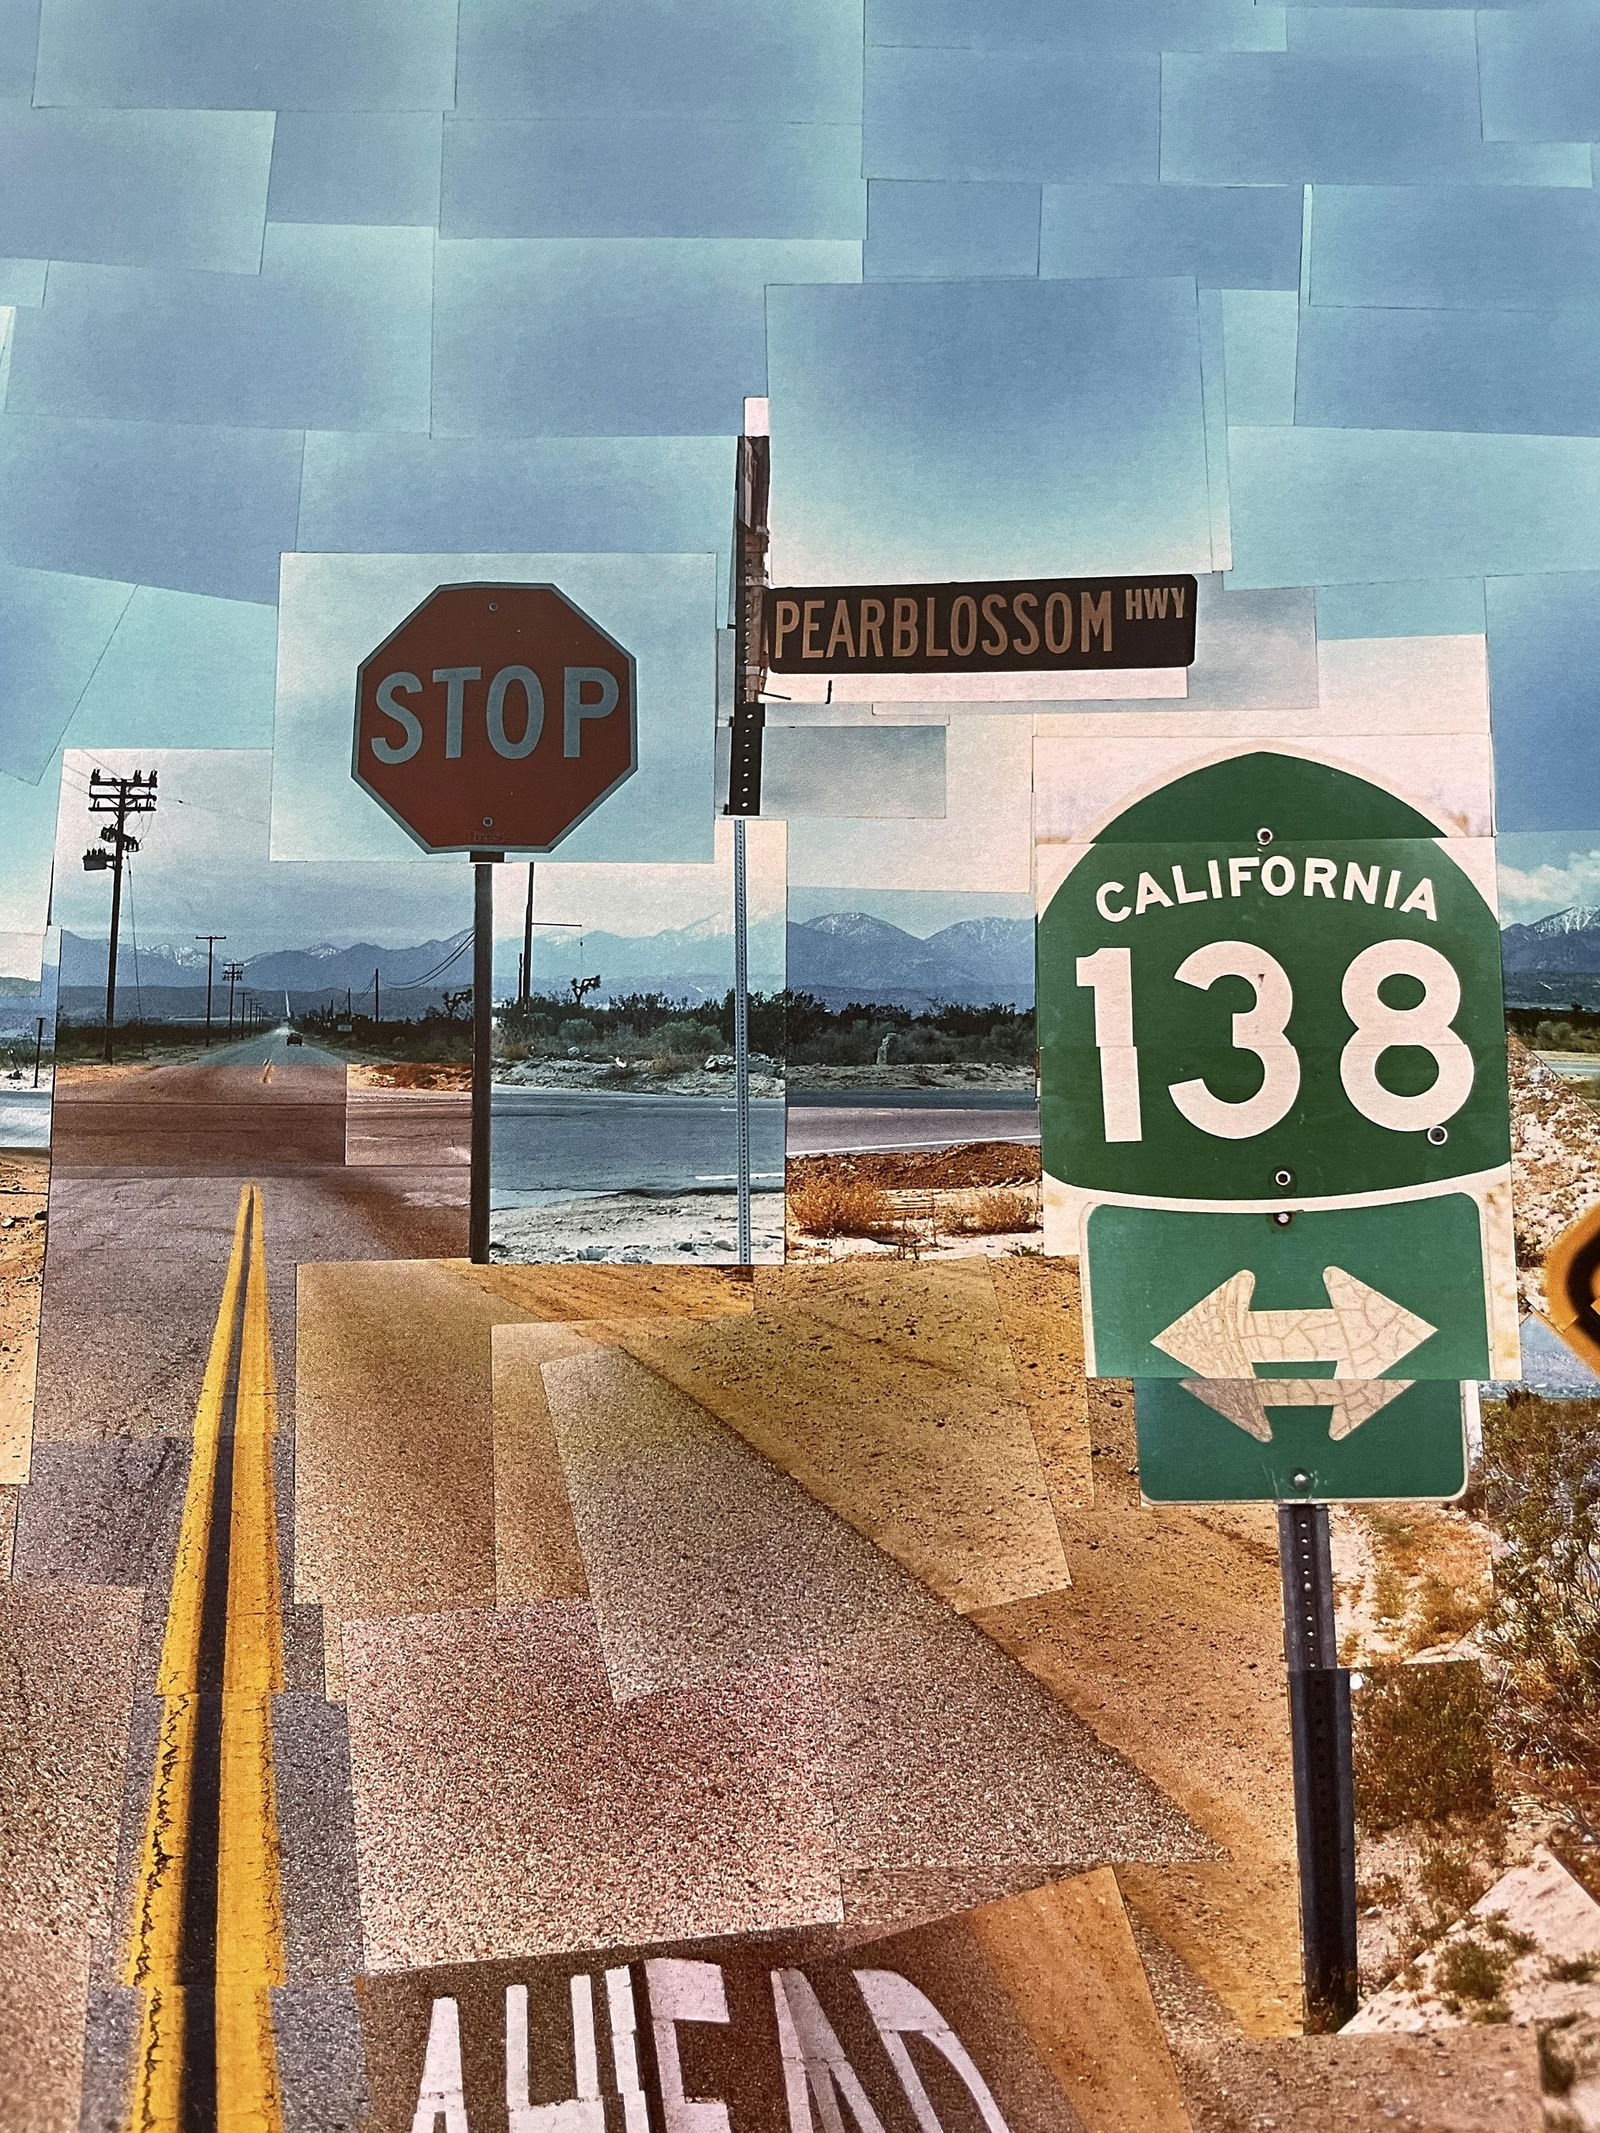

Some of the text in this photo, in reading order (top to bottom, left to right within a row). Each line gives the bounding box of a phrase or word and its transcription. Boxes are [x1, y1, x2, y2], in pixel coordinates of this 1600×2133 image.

[773, 586, 1187, 661] PEARBLOSSOM HWY
[370, 664, 621, 766] STOP
[1095, 855, 1438, 923] CALIFORNIA
[1075, 939, 1475, 1143] 138
